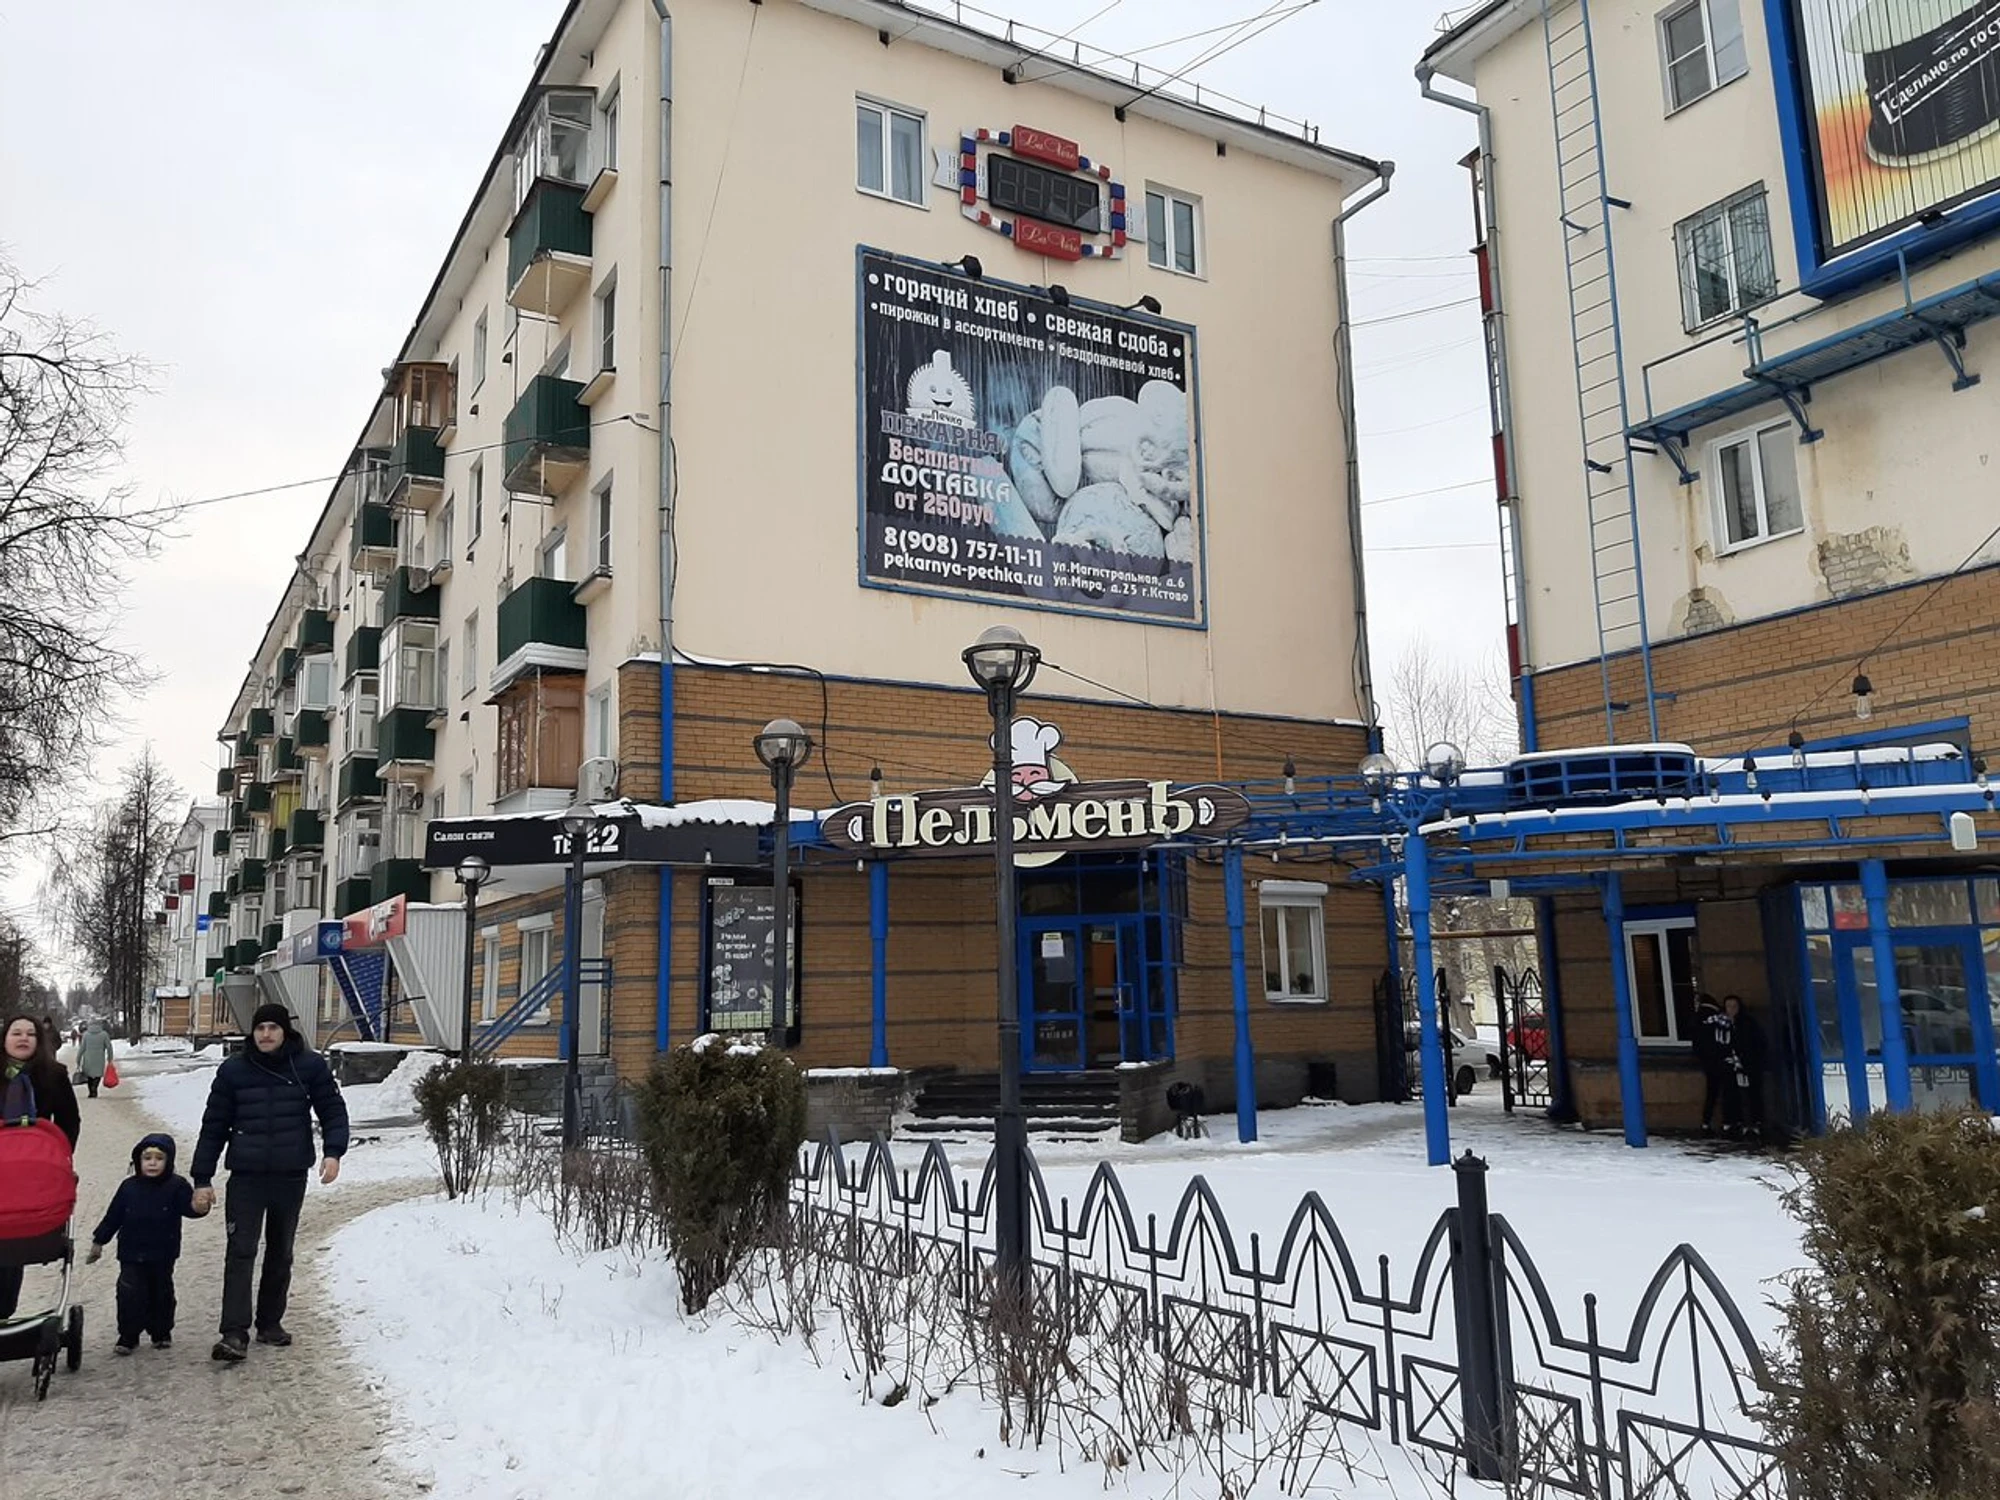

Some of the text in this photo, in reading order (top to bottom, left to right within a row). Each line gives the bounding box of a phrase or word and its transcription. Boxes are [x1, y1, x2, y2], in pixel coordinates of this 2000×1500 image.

[1890, 17, 2000, 109] СДЕЛАНО по ГОС
[884, 273, 1168, 358] горячий хлеб свежая сдоба
[879, 302, 1174, 381] пирожки в ассортименте бездрожжевой хлеб
[881, 410, 1004, 456] ПЕКАРНЯ
[888, 437, 1003, 477] Бесплат
[894, 491, 917, 511] от
[884, 526, 1042, 568] 8(908) 757-11-11
[884, 552, 1044, 587] pekarnya-pechka.ru
[1166, 577, 1186, 589] д.6
[1110, 583, 1138, 595] д.25
[1142, 587, 1189, 602] г.Кстово
